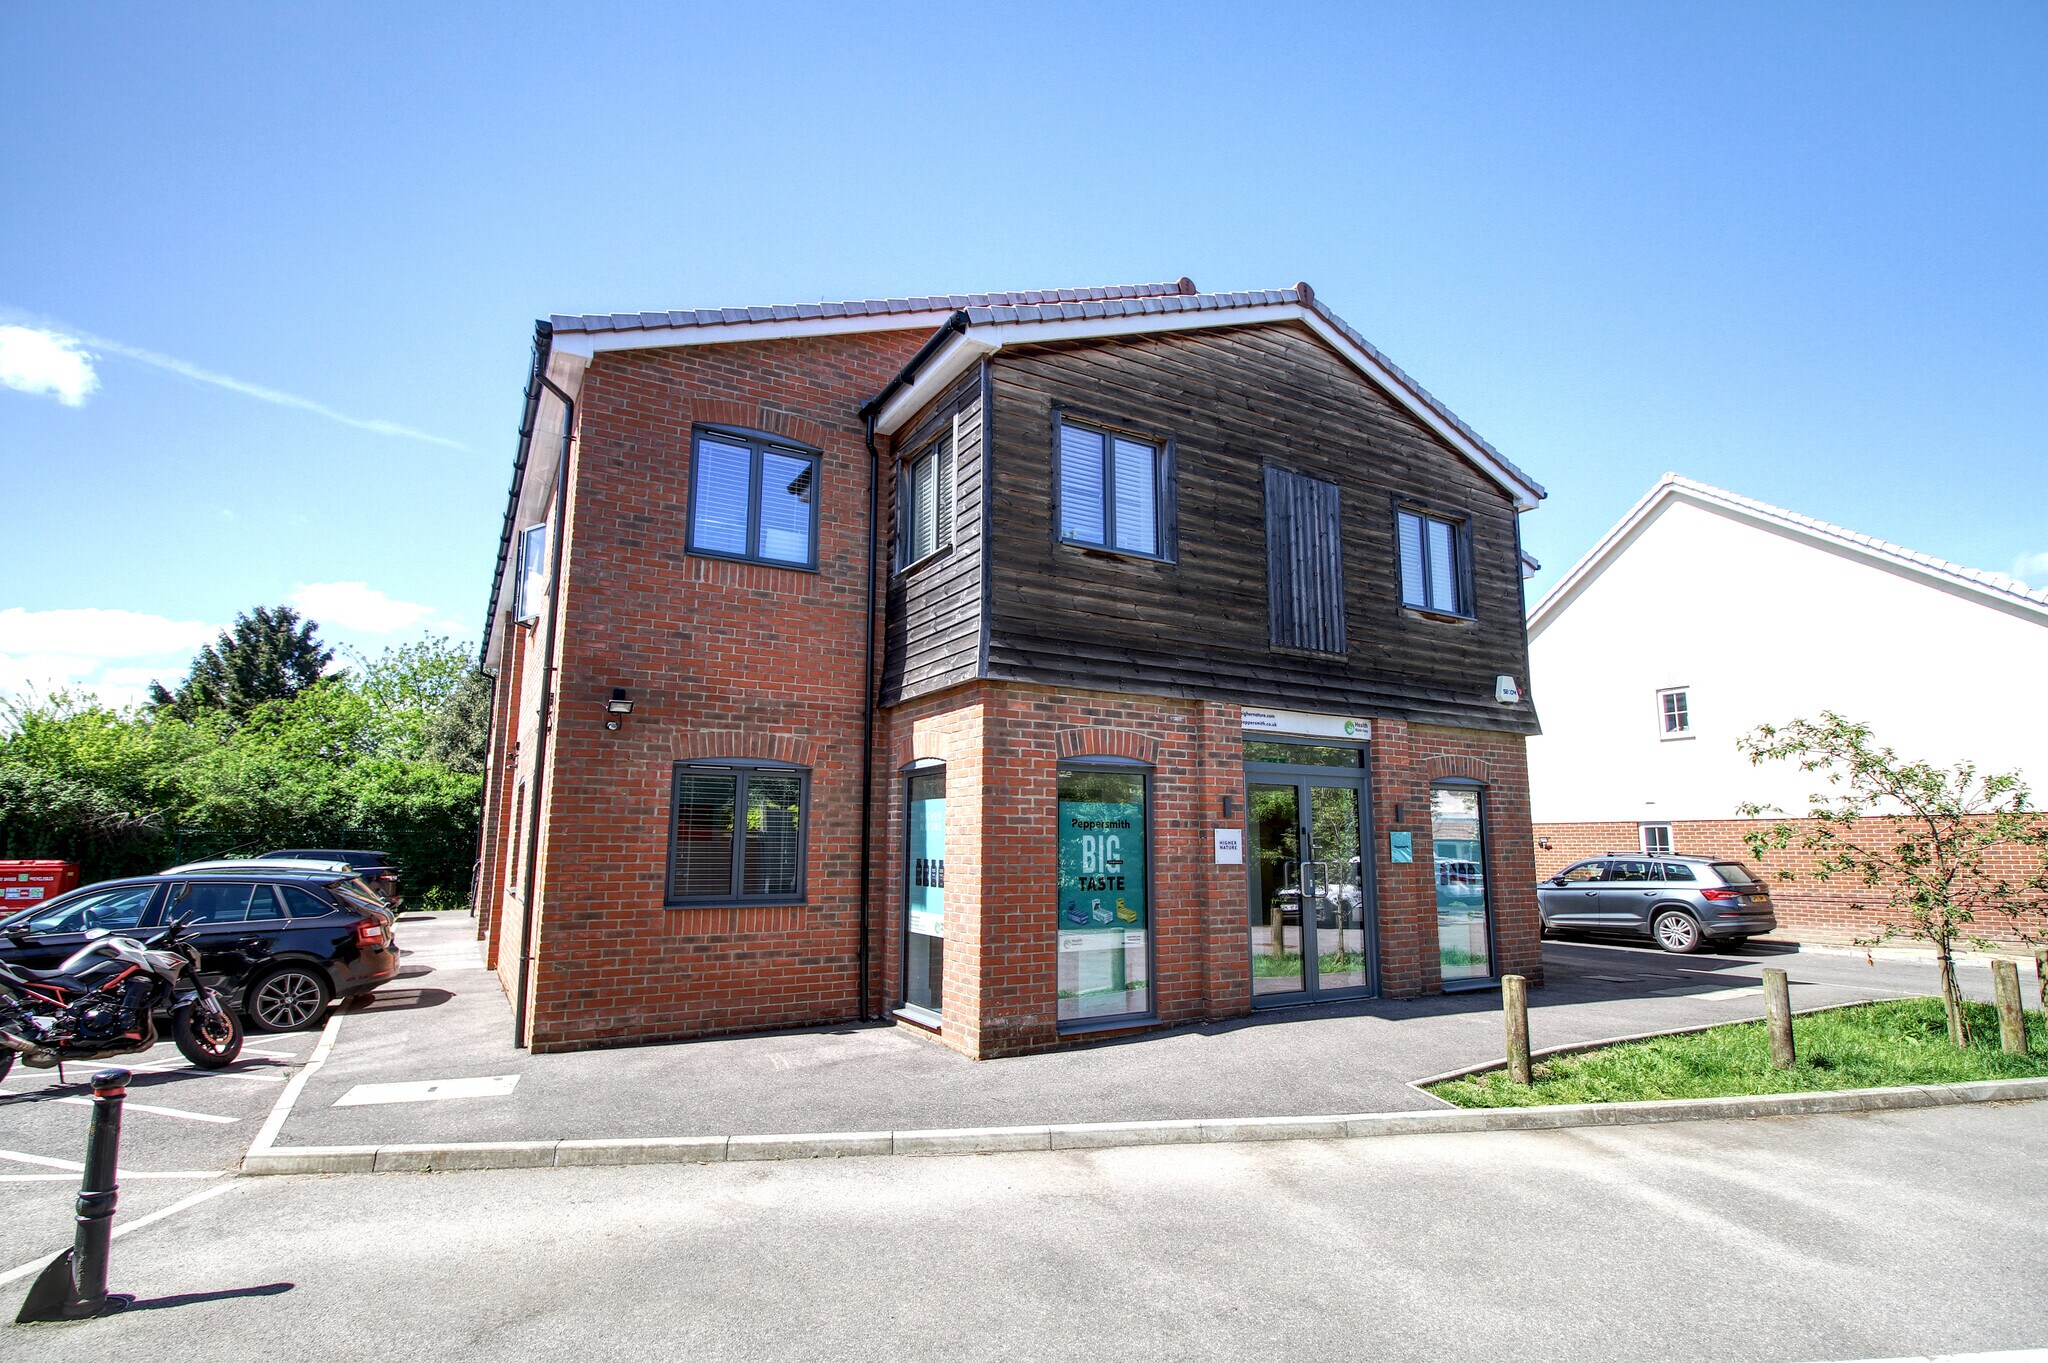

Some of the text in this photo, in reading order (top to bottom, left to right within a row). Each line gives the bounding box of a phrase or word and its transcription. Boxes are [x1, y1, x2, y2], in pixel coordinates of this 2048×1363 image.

[1071, 818, 1131, 831] Peppersmith
[1082, 834, 1121, 873] BIG
[1078, 876, 1125, 892] TASTE
